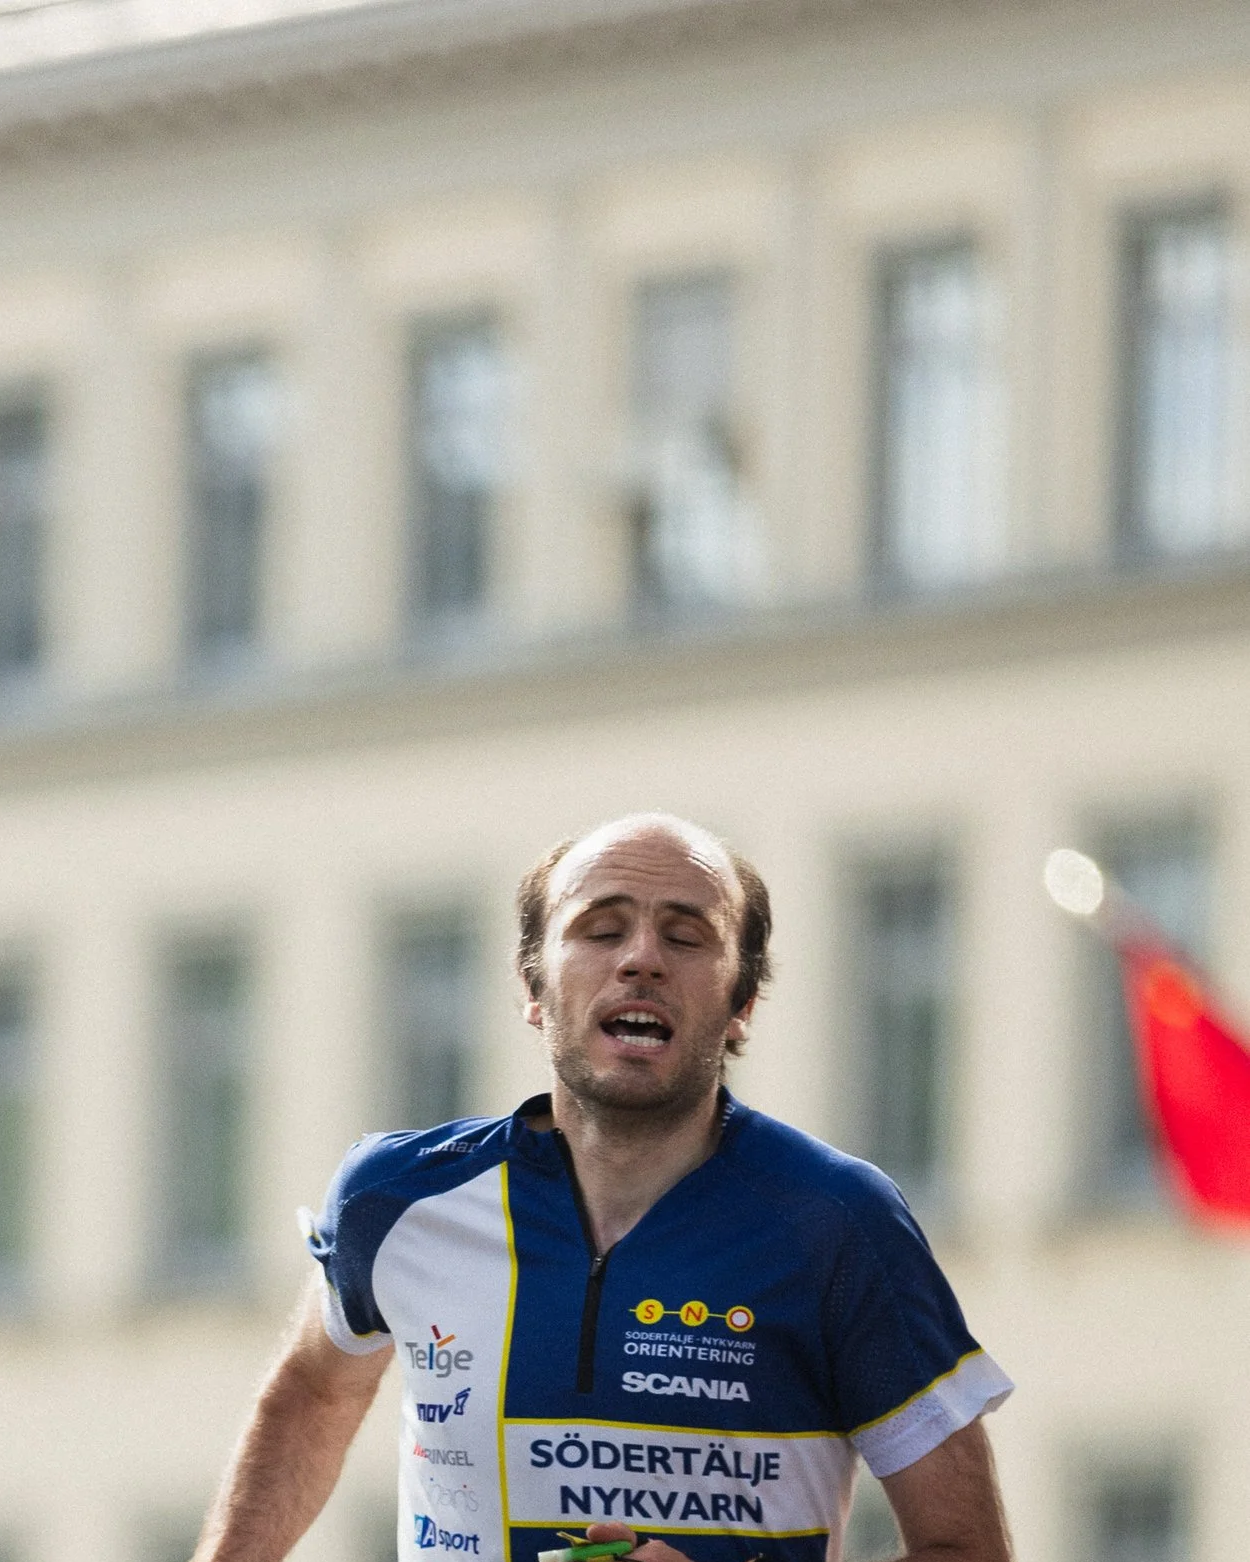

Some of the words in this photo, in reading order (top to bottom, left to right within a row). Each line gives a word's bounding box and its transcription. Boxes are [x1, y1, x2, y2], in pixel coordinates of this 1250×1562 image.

[623, 1342, 755, 1366] ORIENTERING
[701, 1336, 756, 1350] NYKVARN
[405, 1342, 474, 1378] Telge
[621, 1371, 751, 1402] SCANIA
[530, 1432, 780, 1487] SÖDERTÄLJE
[559, 1485, 763, 1524] NYKVARN
[438, 1529, 480, 1555] sport
